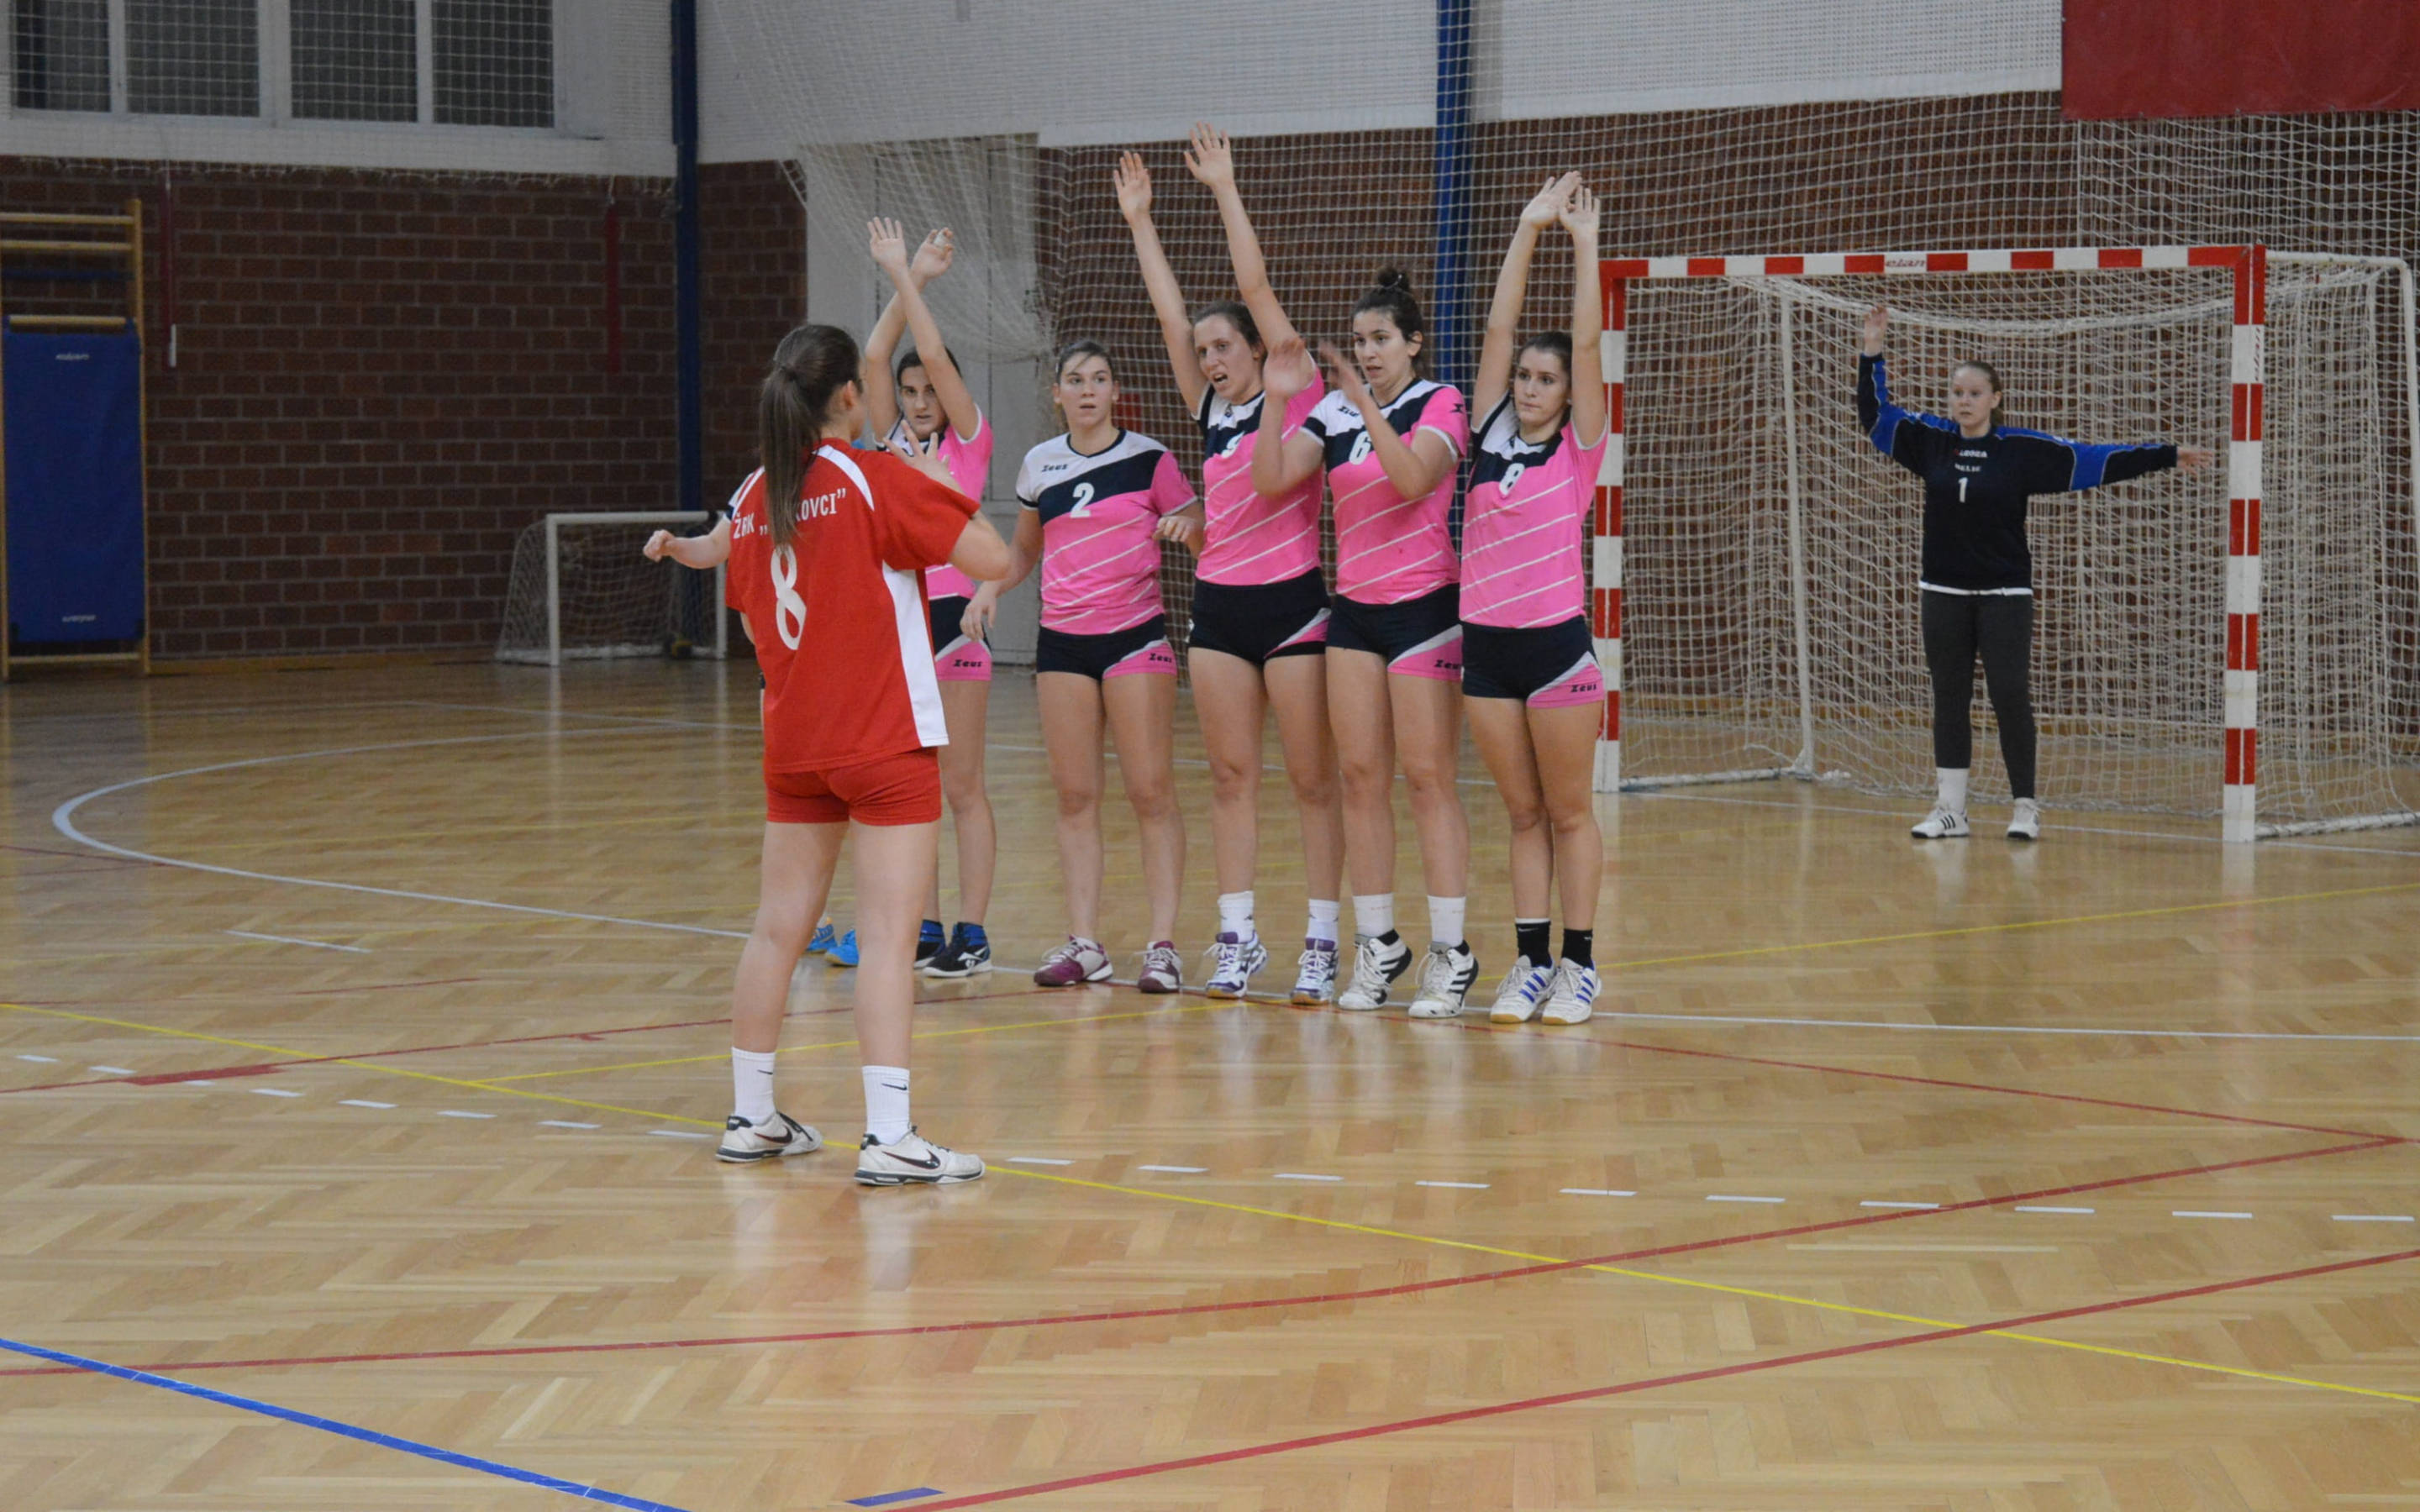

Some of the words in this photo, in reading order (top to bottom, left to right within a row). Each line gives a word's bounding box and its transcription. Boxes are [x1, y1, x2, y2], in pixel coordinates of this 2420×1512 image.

[1349, 430, 1372, 465] 6
[1041, 464, 1068, 472] Zeus
[1958, 476, 1968, 503] 1
[1070, 482, 1095, 518] 2
[771, 544, 807, 651] 8
[953, 659, 982, 668] Zeus
[1149, 653, 1172, 663] Zeus
[1434, 659, 1462, 670] Zeu
[1570, 684, 1597, 693] Zeus
